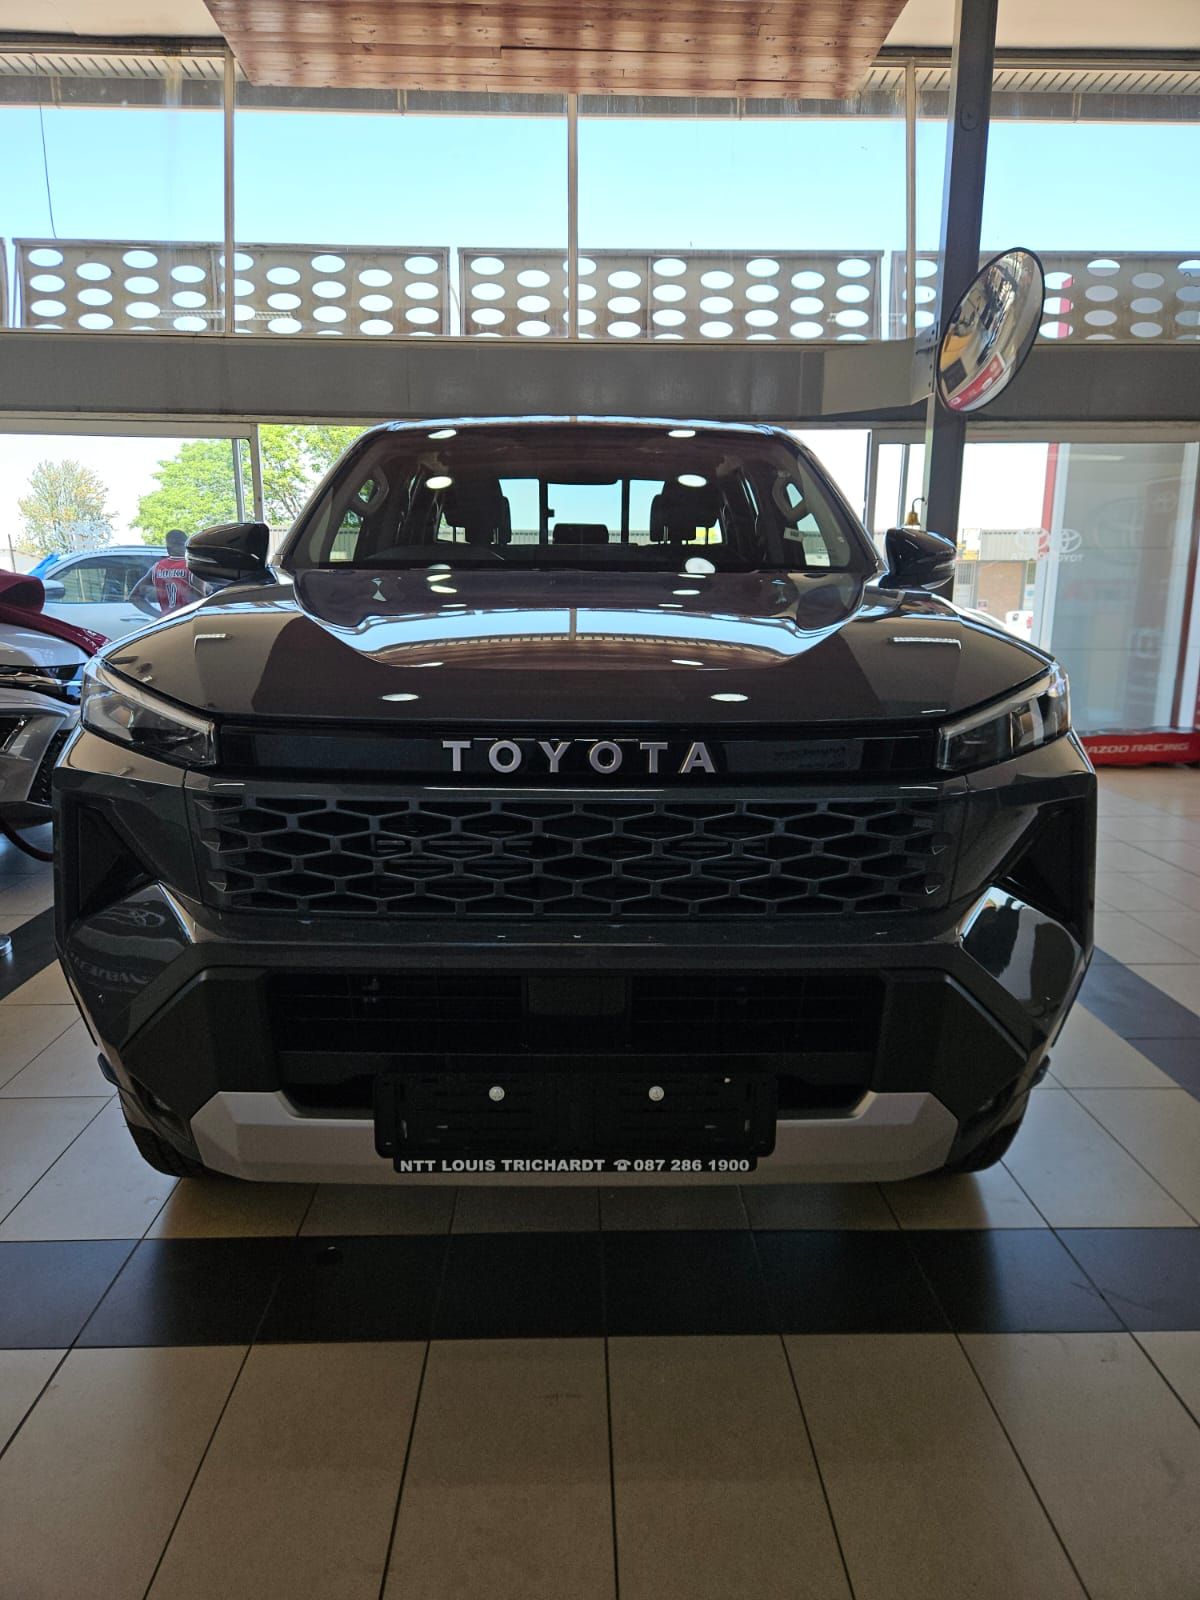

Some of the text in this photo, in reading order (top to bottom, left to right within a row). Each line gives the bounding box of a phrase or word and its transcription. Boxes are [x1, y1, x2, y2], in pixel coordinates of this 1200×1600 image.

[1085, 742, 1190, 755] AZOO RACING
[441, 740, 717, 774] TOYOTA
[400, 1159, 750, 1172] NTT LOUIS TRICHARDT 087 286 1900
